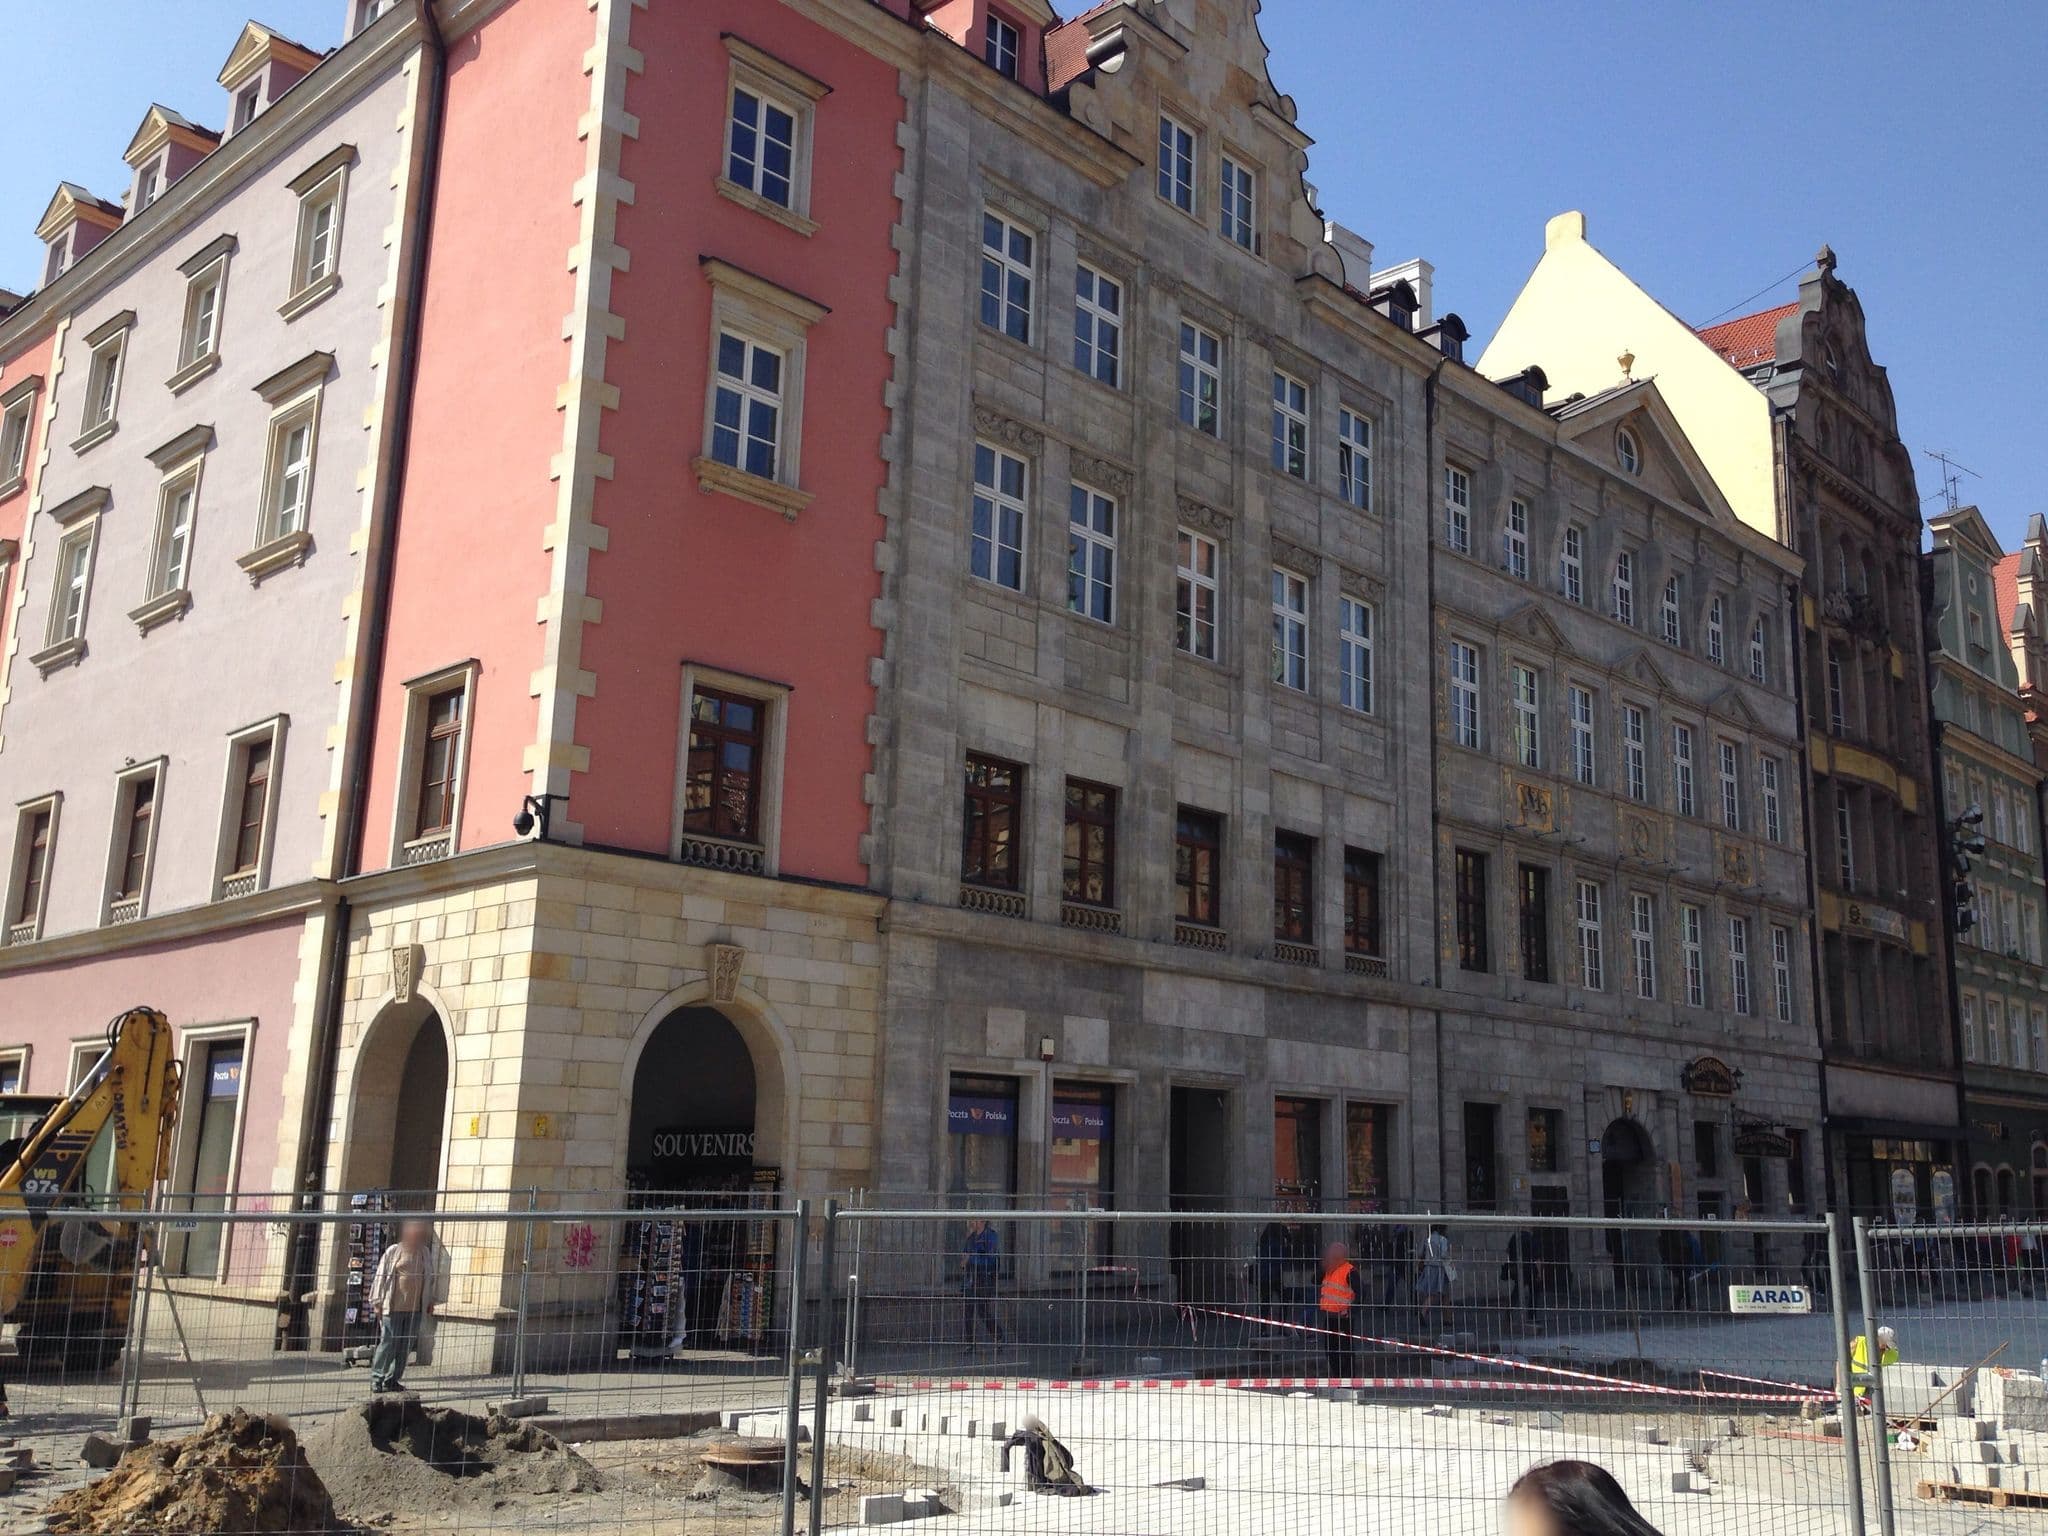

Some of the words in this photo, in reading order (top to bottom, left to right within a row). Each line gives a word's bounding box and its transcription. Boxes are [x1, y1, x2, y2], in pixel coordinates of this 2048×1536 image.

[985, 1111, 1007, 1121] Polska
[1084, 1117, 1104, 1126] Polska
[653, 1133, 755, 1157] SOUVENIRS
[34, 1168, 57, 1178] WB
[1752, 1290, 1804, 1304] ARAD
